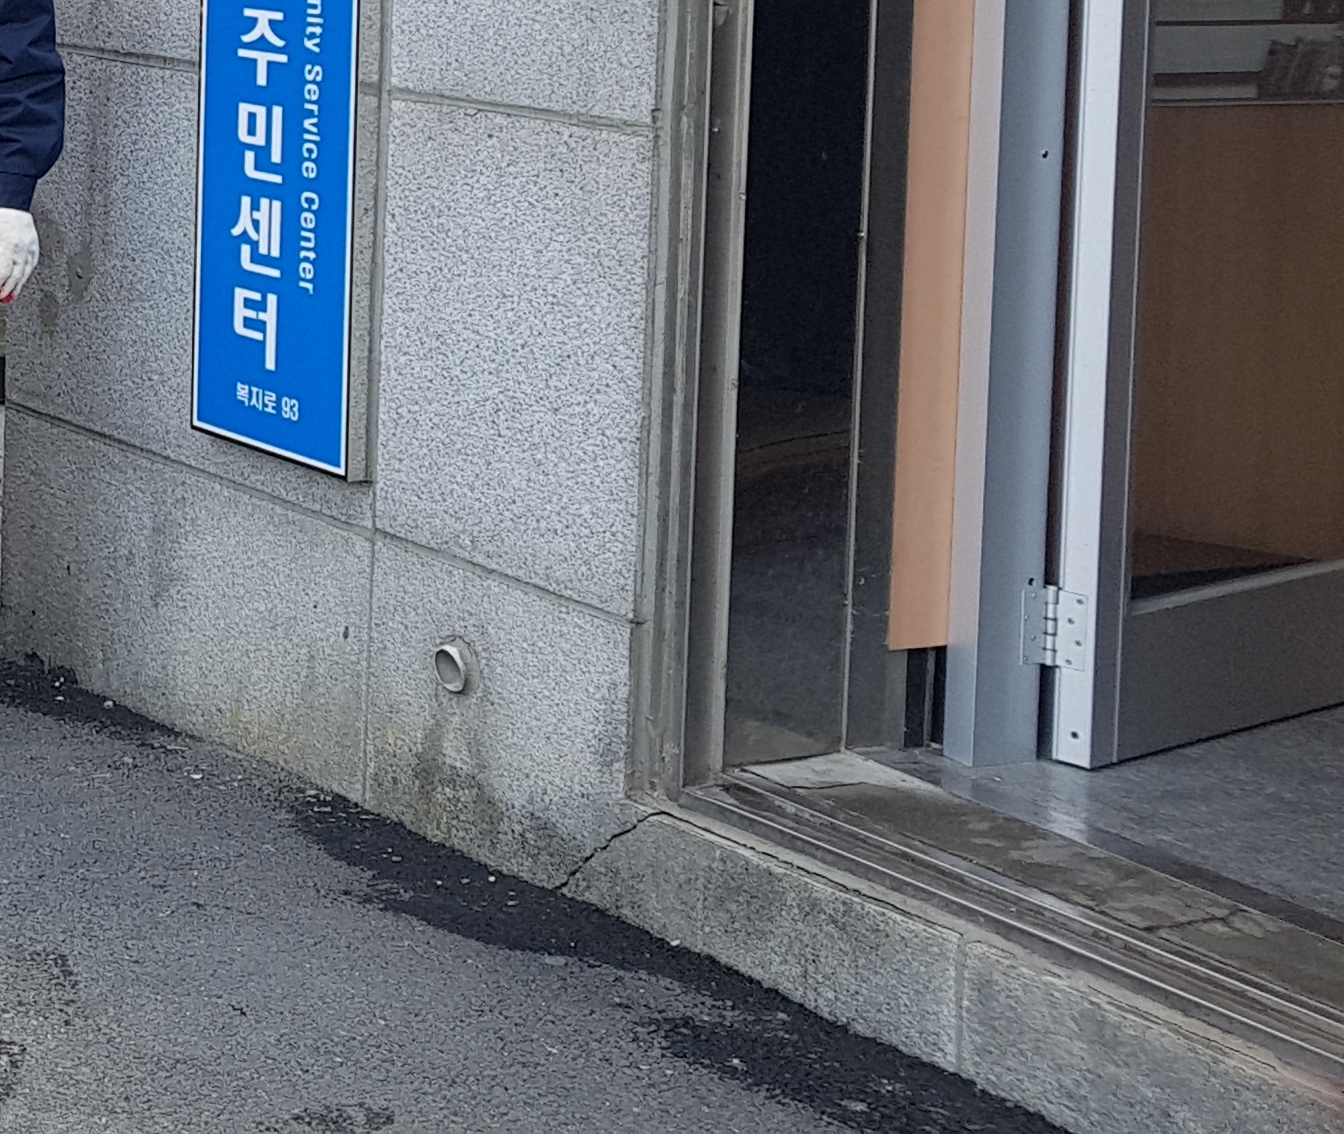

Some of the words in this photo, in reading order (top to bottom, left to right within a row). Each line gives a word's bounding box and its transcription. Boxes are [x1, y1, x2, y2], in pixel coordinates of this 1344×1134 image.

[302, 64, 323, 178] Service
[231, 8, 288, 371] 주민센터
[298, 191, 320, 294] Center
[236, 381, 277, 416] 복지로
[281, 397, 299, 422] 93
